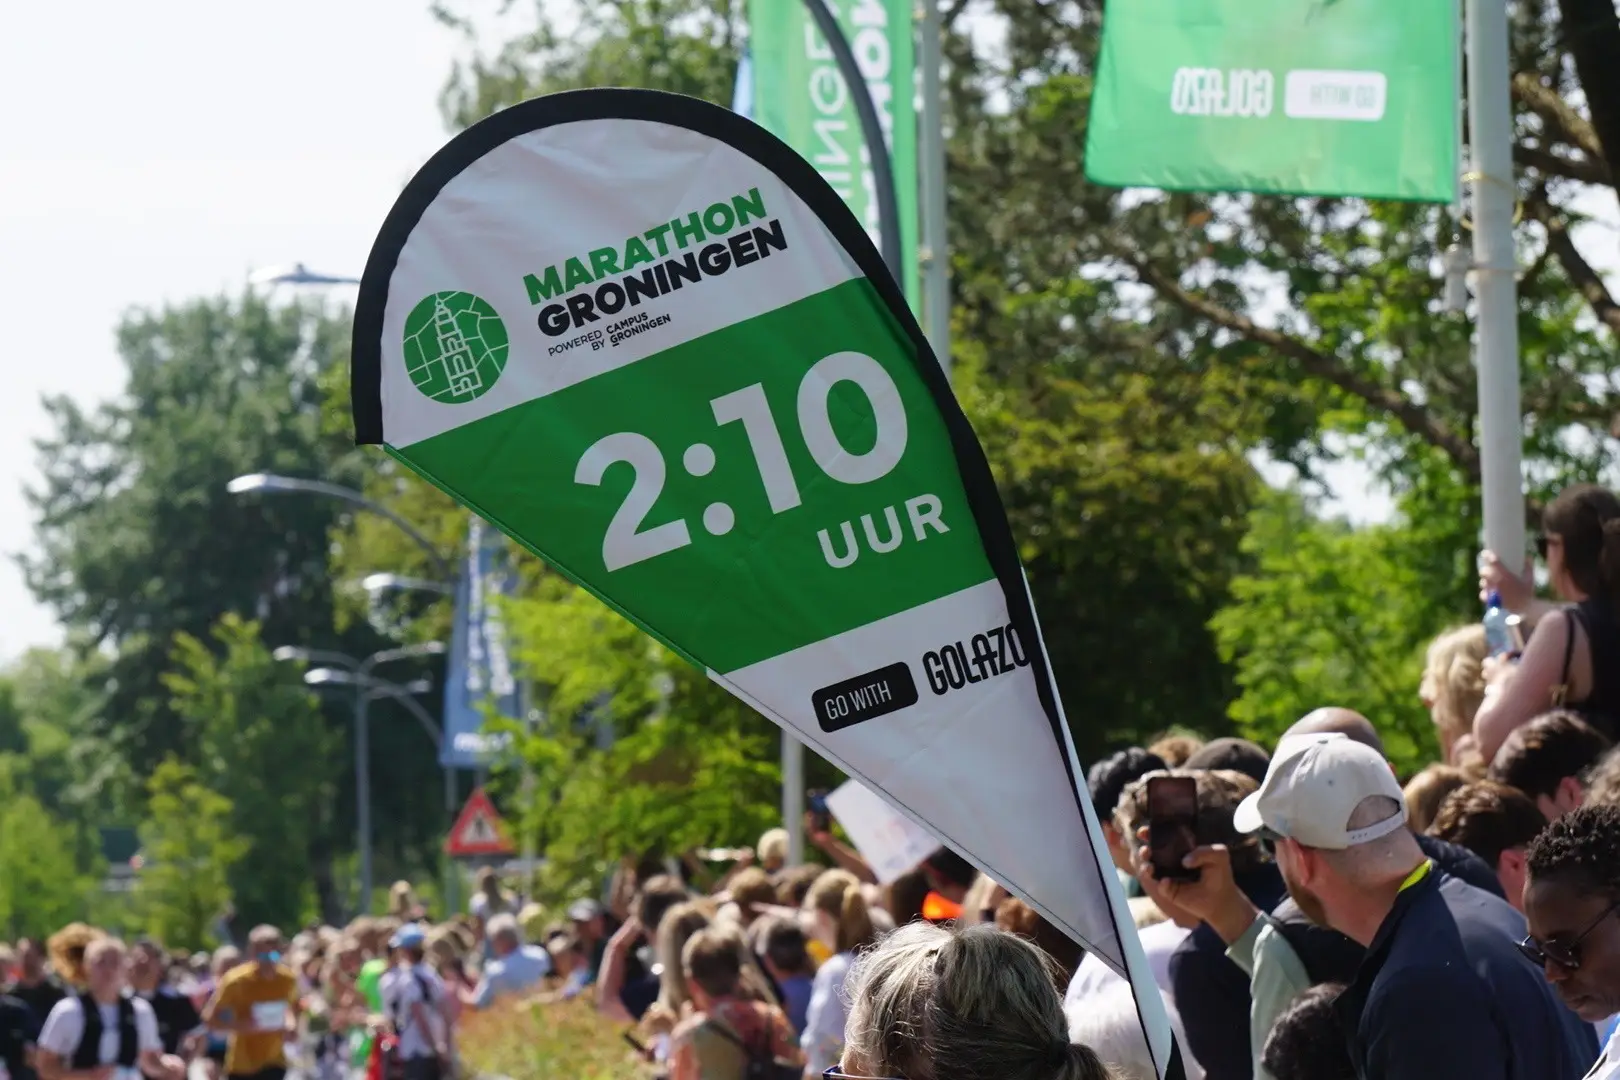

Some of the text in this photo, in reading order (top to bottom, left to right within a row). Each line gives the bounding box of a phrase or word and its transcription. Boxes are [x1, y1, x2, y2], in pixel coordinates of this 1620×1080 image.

[523, 187, 767, 305] MARATHON
[537, 219, 788, 336] GRONINGEN
[548, 311, 649, 356] POWERED CAMPUS
[591, 313, 672, 351] BY GRONINGEN
[574, 351, 908, 573] 2:10
[816, 493, 951, 568] UUR
[825, 694, 850, 720] GO
[849, 680, 892, 712] WITH
